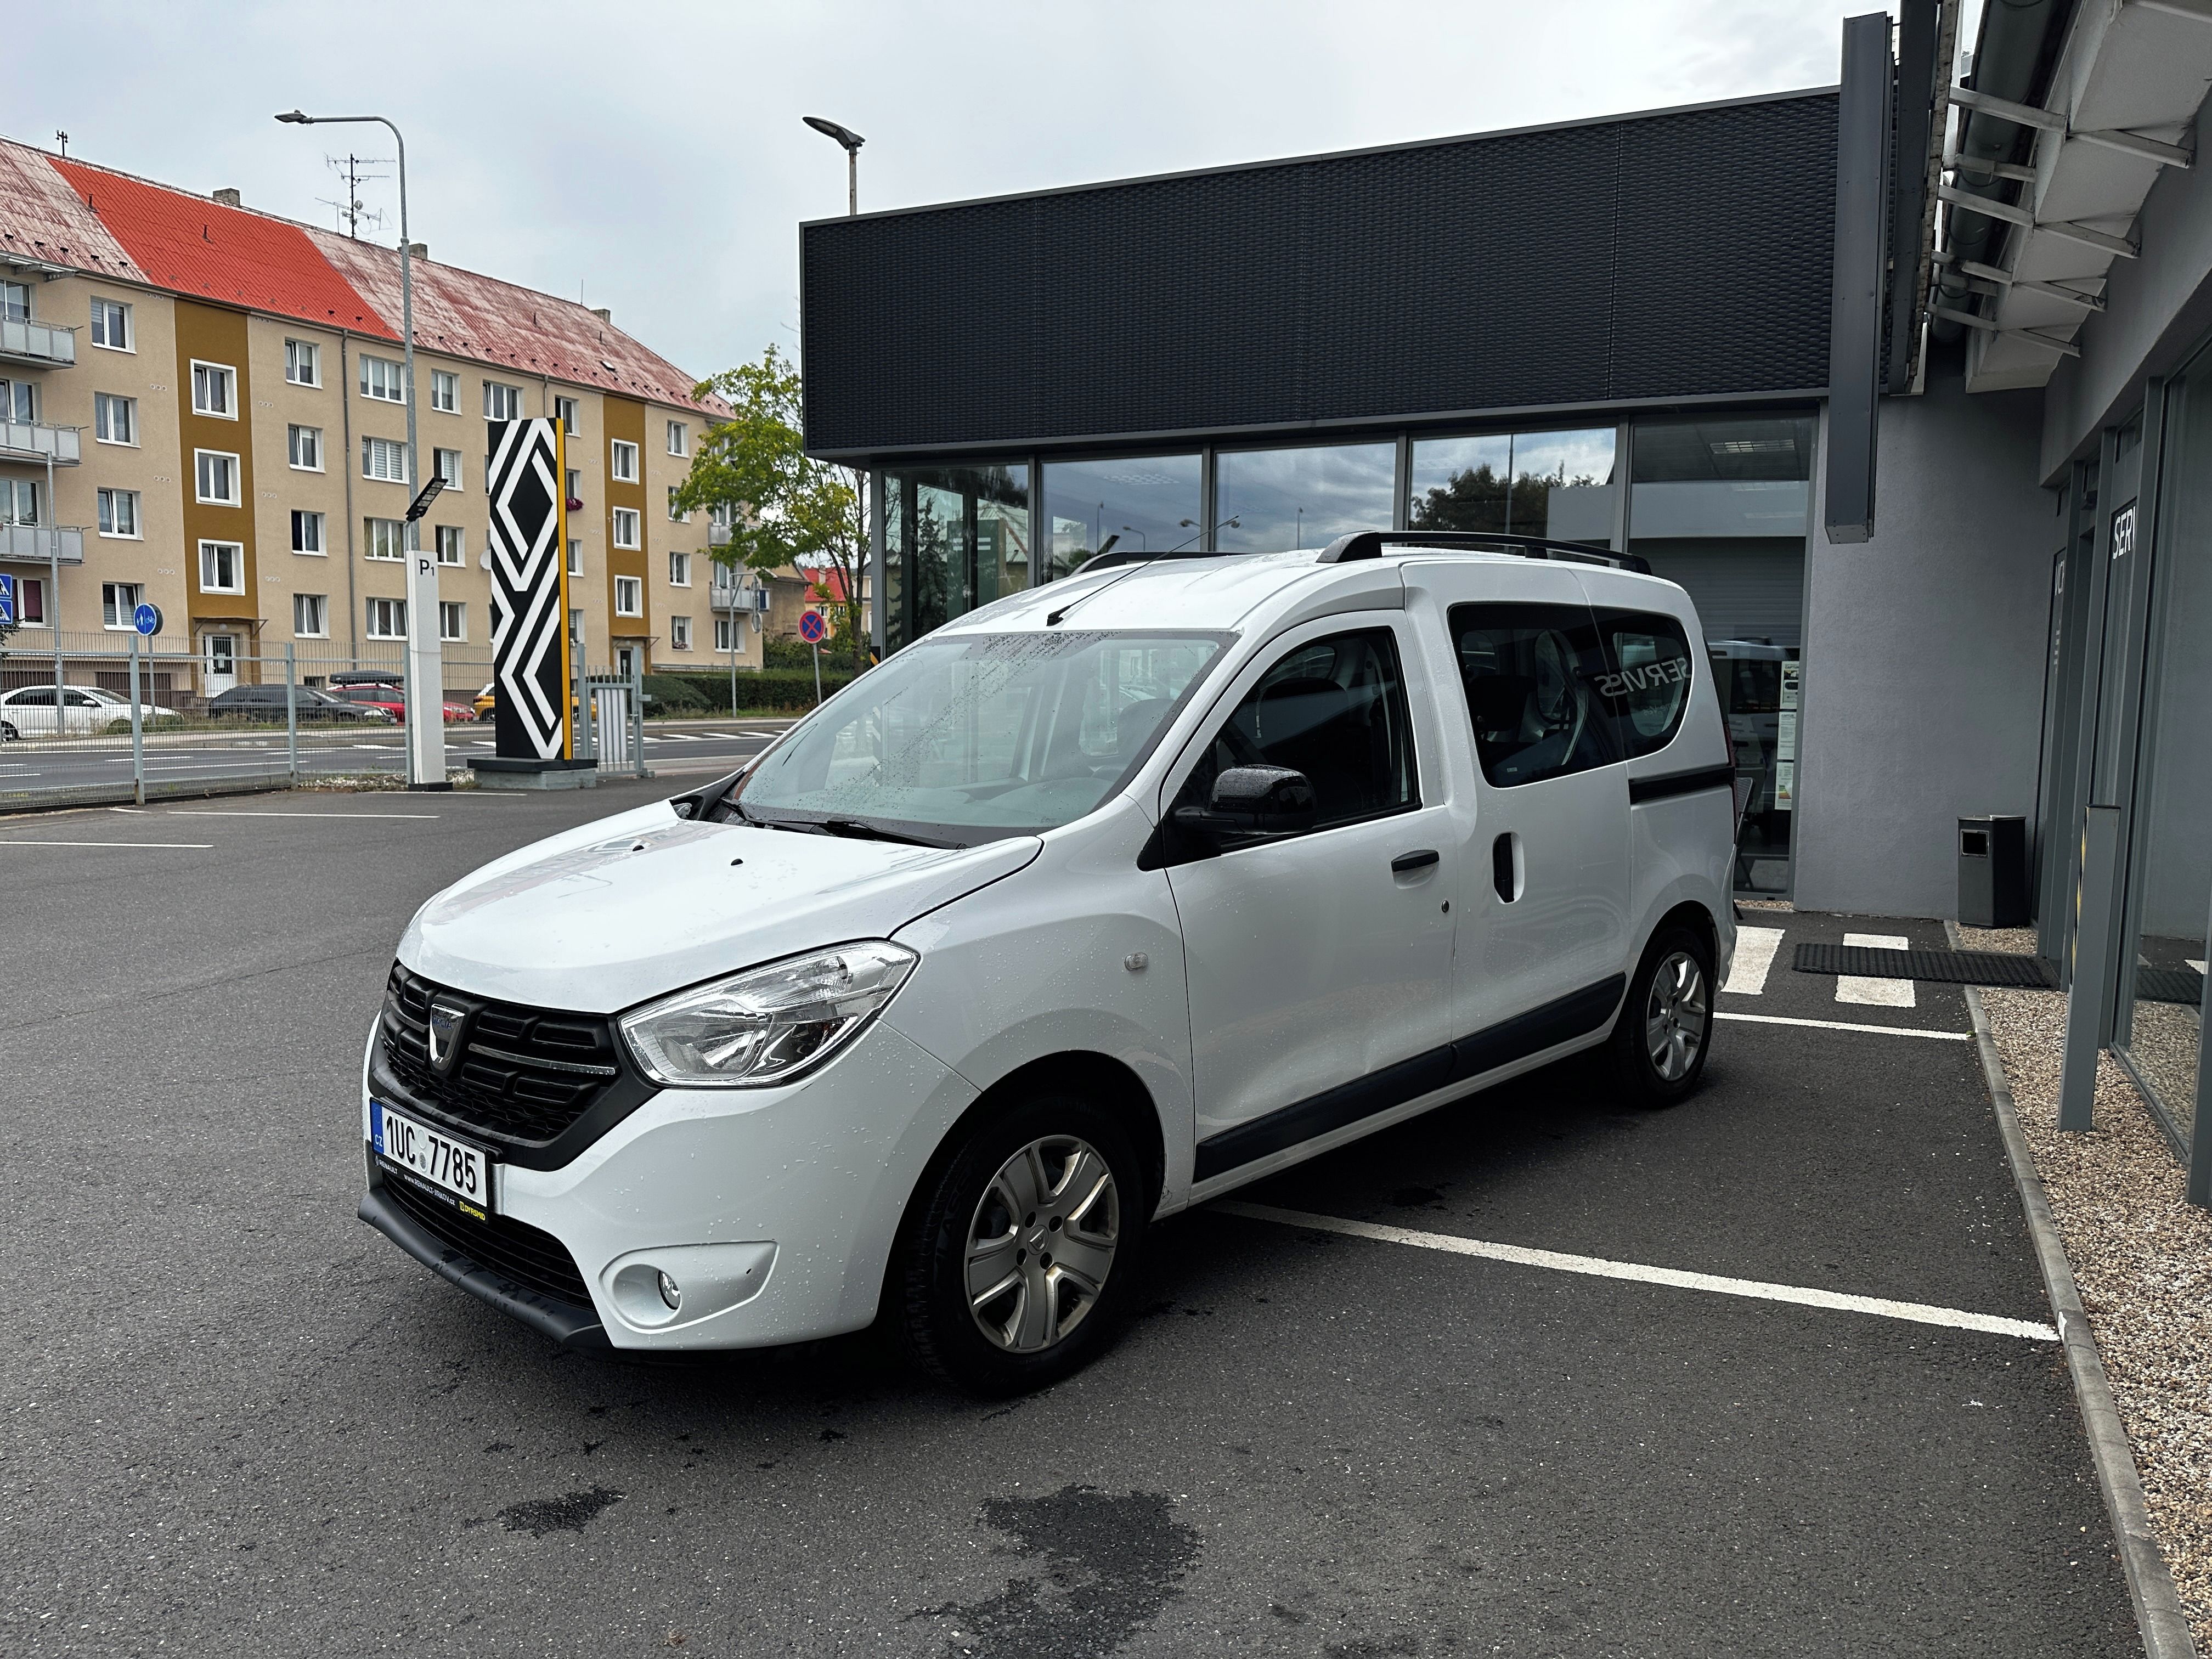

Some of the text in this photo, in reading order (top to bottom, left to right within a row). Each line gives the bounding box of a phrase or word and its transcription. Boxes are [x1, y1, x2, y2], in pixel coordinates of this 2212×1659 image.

[375, 1134, 383, 1147] CZ
[386, 1116, 476, 1194] 1UC 7785
[379, 1159, 398, 1175] RENAULT
